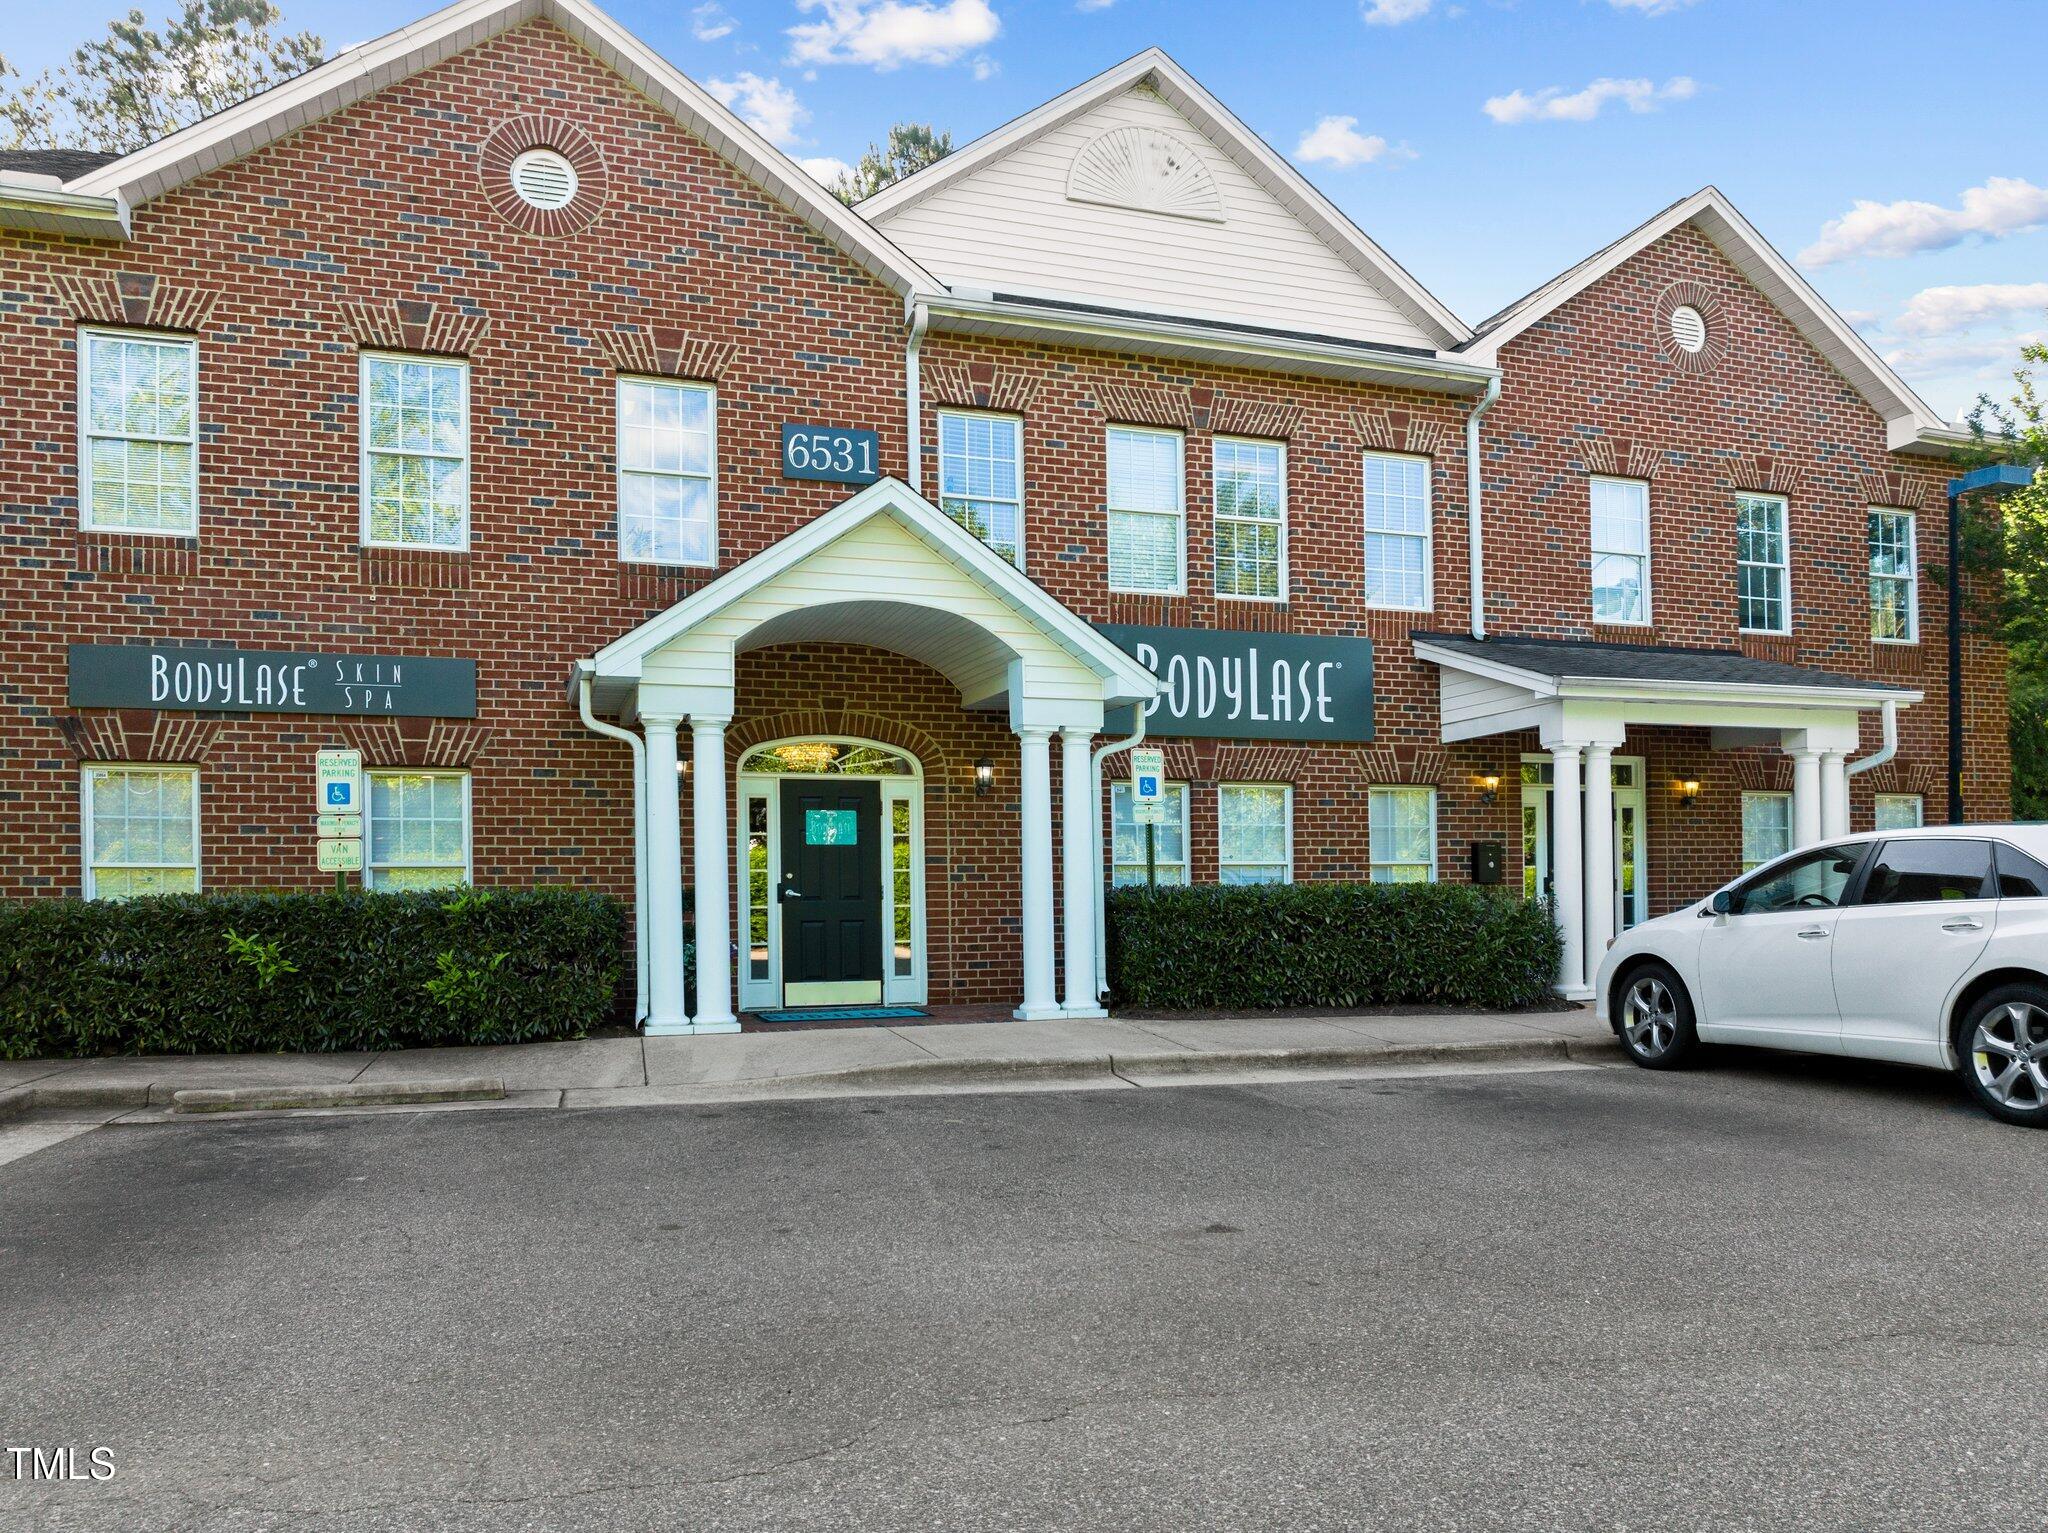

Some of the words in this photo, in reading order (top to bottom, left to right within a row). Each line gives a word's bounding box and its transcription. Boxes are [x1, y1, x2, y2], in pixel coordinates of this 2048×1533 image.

[788, 433, 876, 475] 6531
[336, 660, 401, 684] SKIN
[344, 686, 392, 709] SPA
[319, 758, 358, 767] RESERVED
[1133, 755, 1161, 764] RESERVED
[322, 769, 356, 778] PARKING
[1135, 764, 1160, 773] PARKING
[330, 844, 349, 854] VAN
[321, 856, 360, 866] ACCESSIBLE
